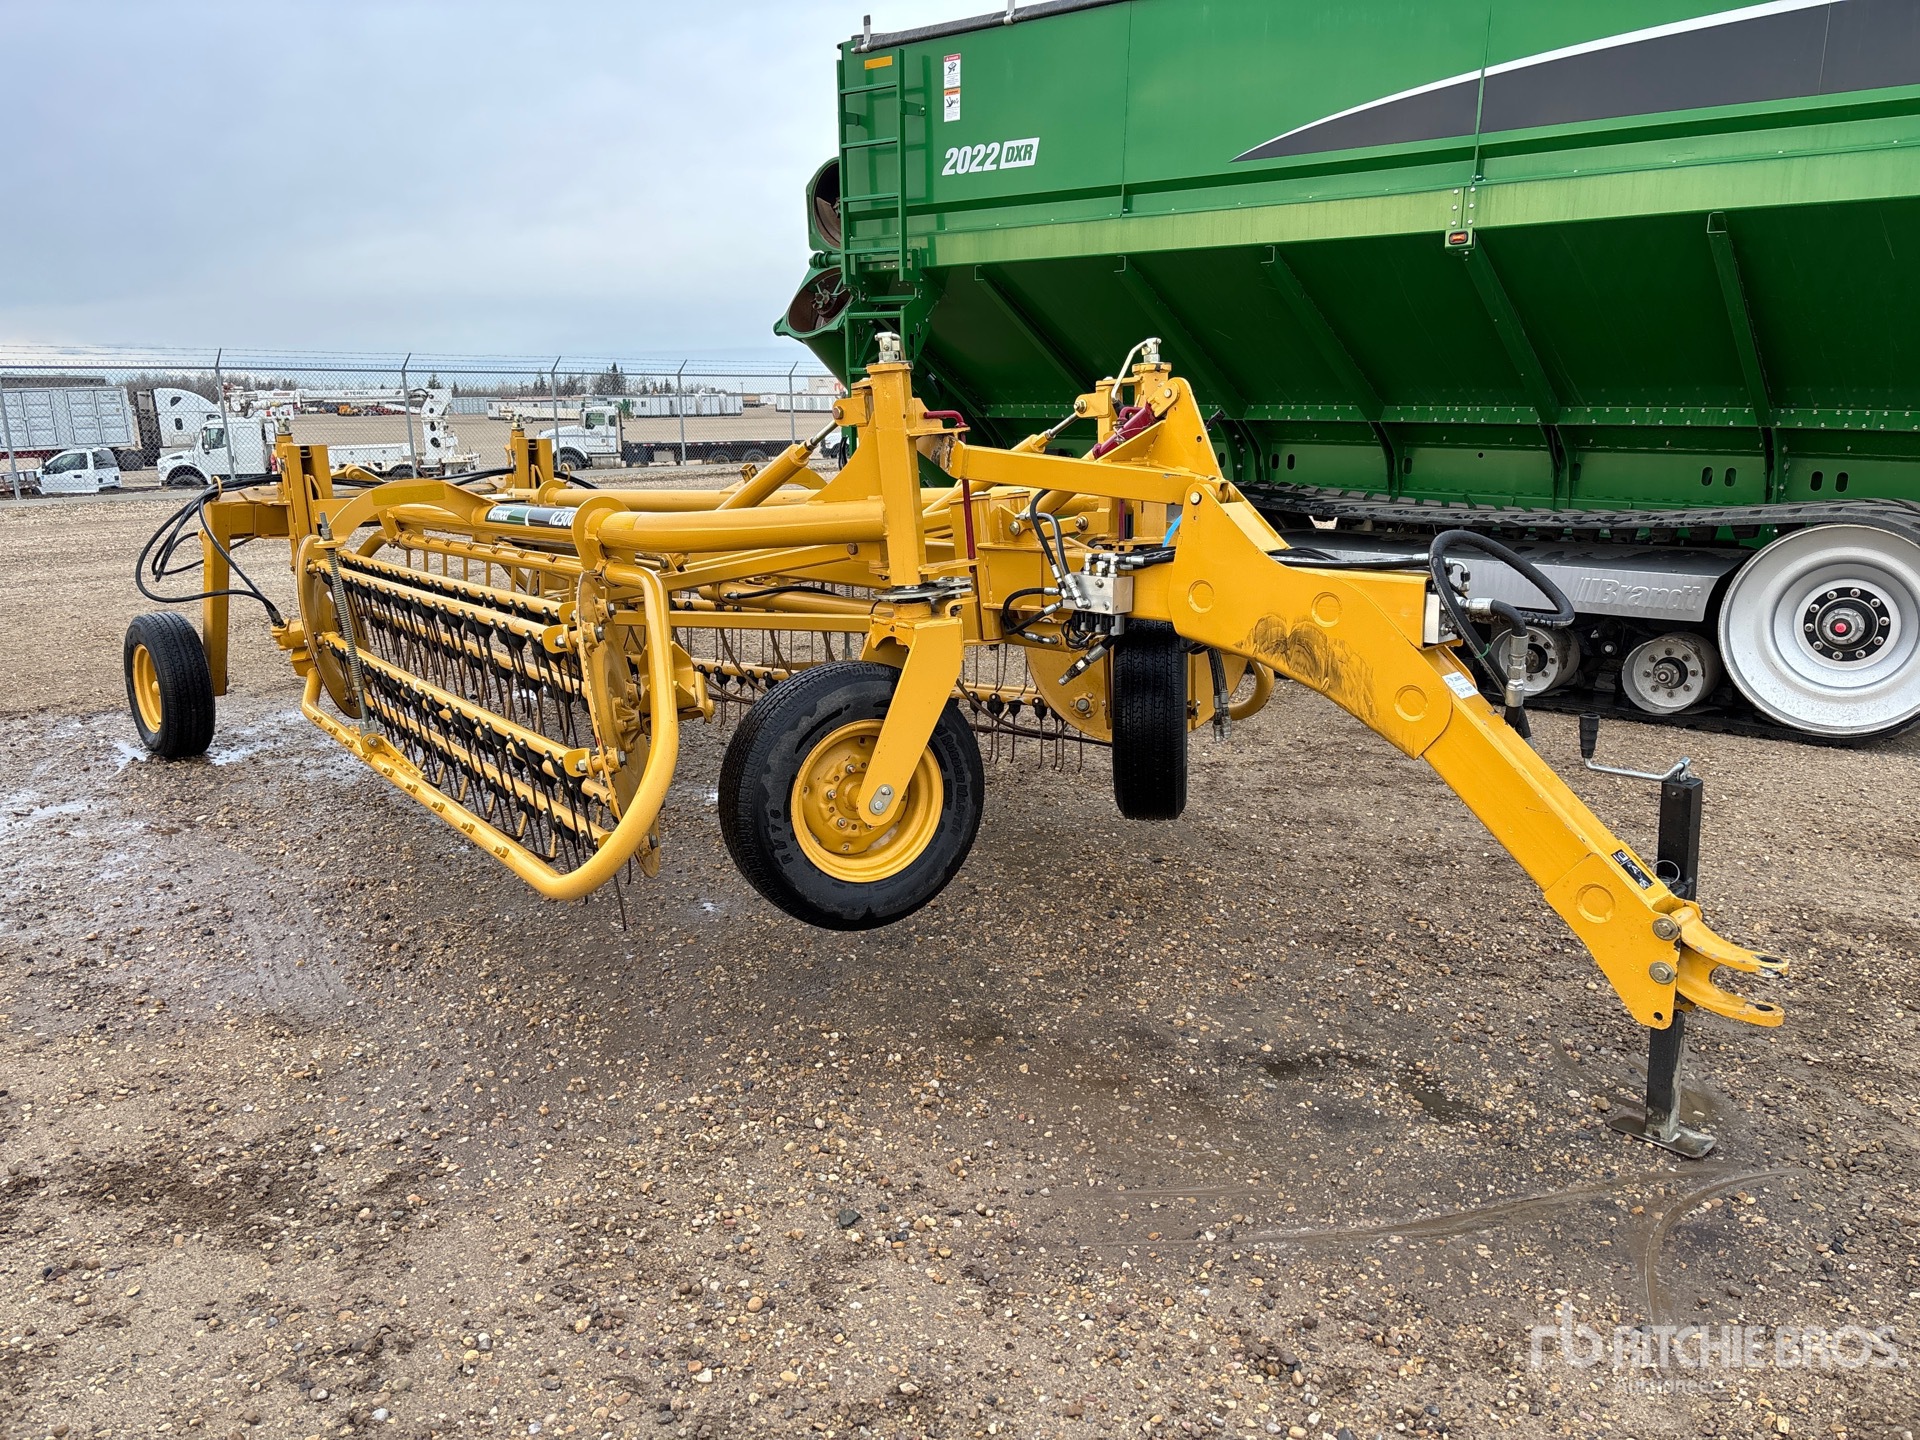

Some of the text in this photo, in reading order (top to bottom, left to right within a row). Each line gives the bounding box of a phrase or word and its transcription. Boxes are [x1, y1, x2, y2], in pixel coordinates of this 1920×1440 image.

[941, 142, 1035, 176] 2022 DXR
[1597, 578, 1701, 612] Brandt
